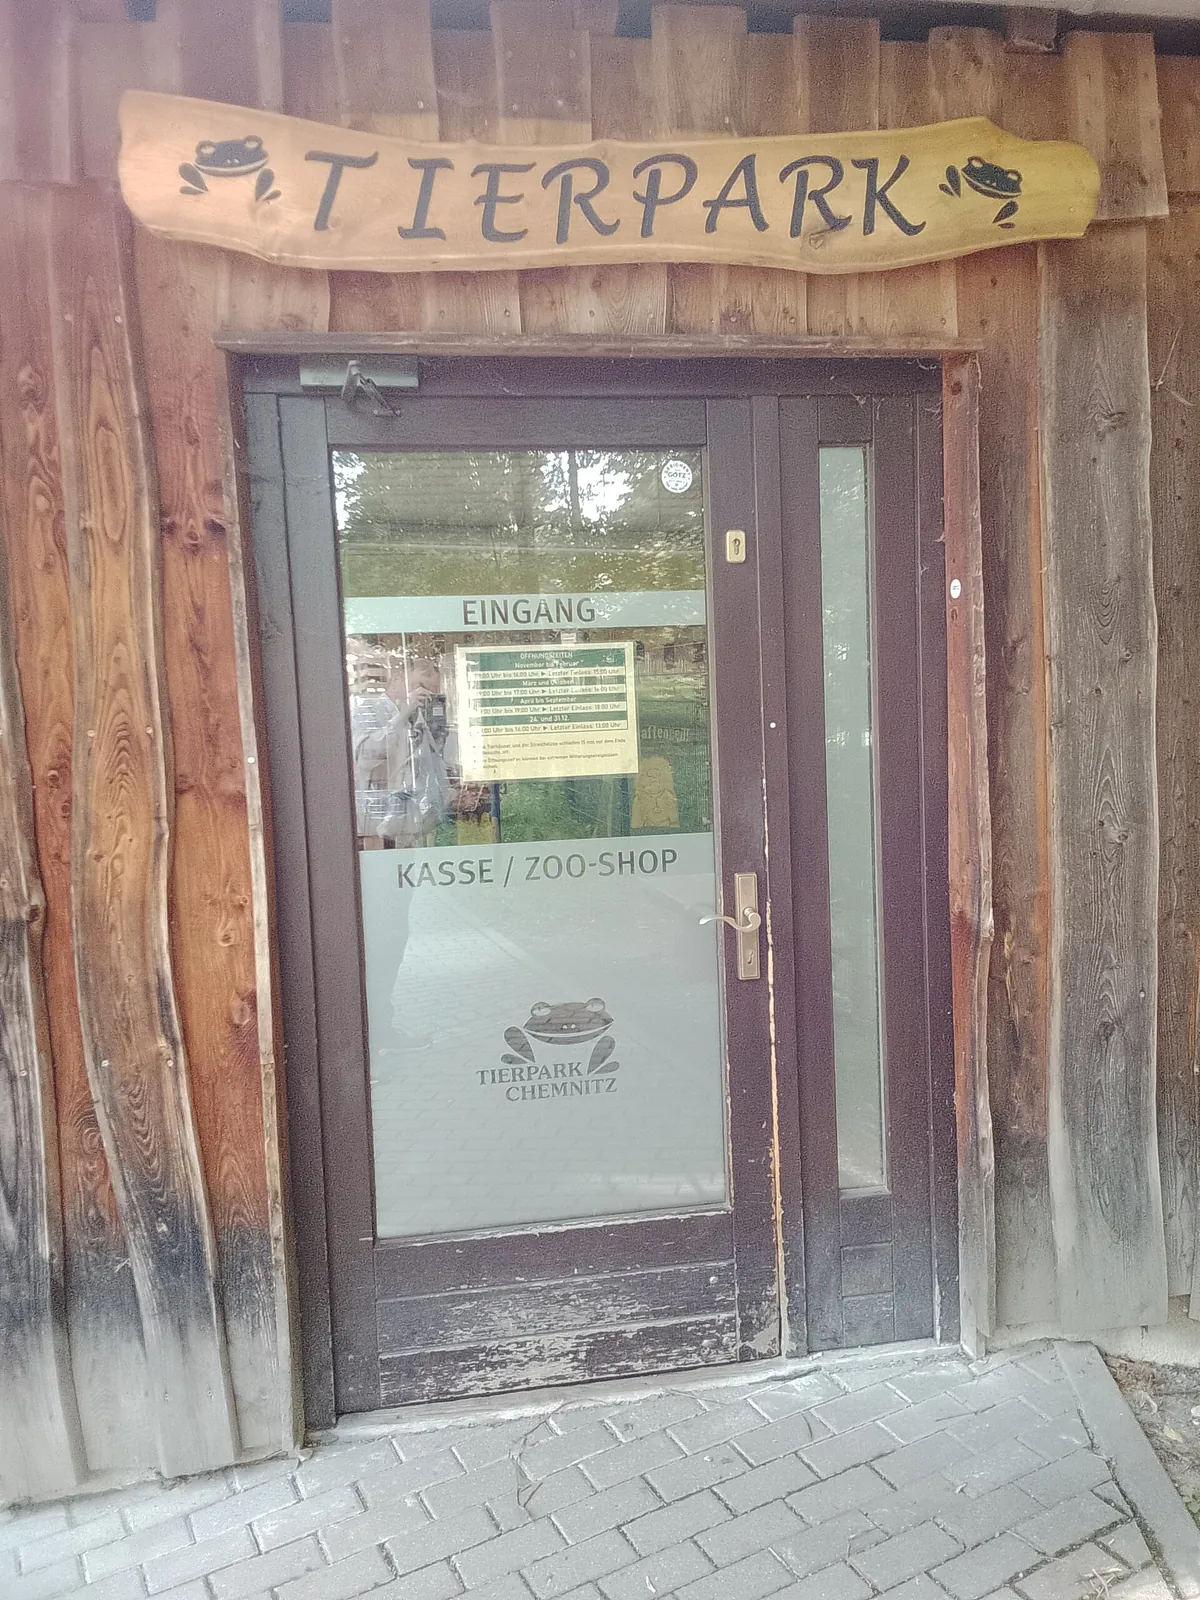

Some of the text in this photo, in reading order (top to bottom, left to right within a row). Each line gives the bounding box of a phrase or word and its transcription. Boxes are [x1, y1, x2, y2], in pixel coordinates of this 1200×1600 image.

[304, 151, 926, 243] TIERPARK
[463, 598, 596, 625] EINGANG
[397, 848, 678, 888] KASSE / ZOO-SHOP
[476, 1061, 583, 1085] TIERPARK
[505, 1077, 618, 1101] CHEMNITZ
